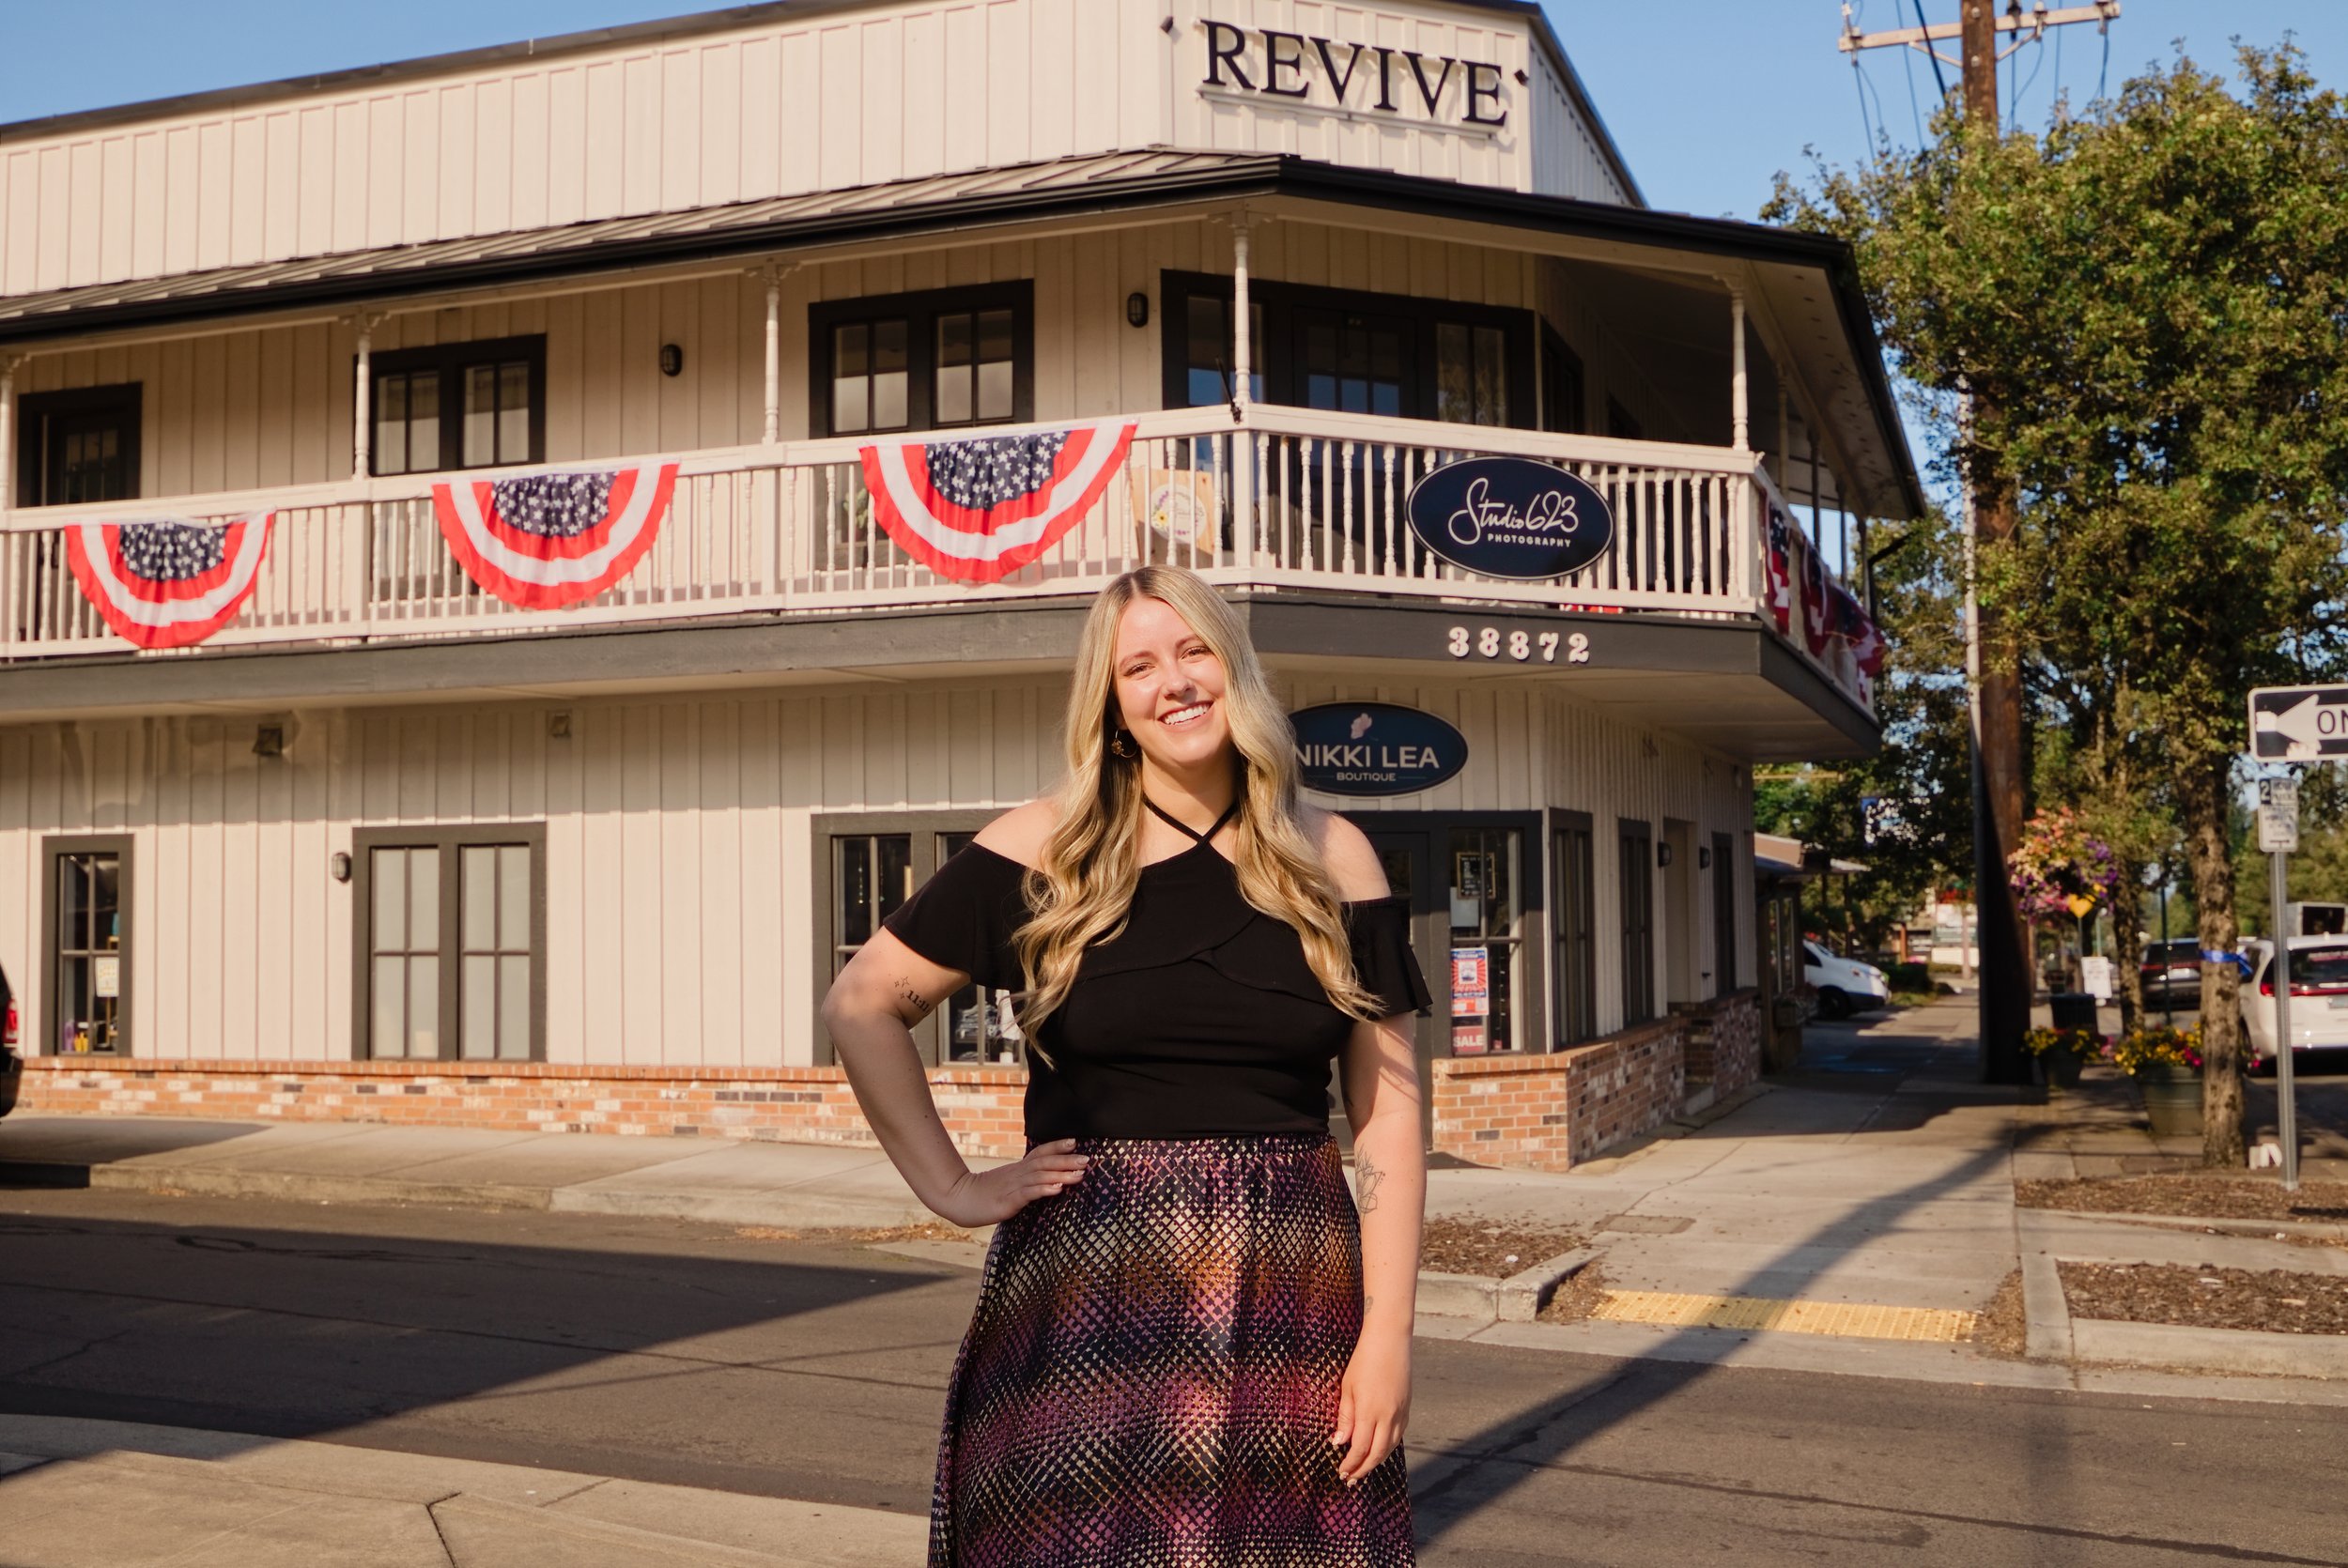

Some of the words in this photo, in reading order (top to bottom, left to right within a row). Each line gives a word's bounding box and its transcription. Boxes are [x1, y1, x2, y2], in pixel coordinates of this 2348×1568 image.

[1200, 19, 1507, 126] REVIVE
[1487, 532, 1571, 547] PHOTOGRAPHY
[1448, 626, 1590, 663] 38872
[1294, 745, 1371, 767] NIKKI
[1383, 746, 1440, 769] LEA
[1336, 773, 1397, 781] BOUTIQUE
[2260, 780, 2270, 801] 2
[906, 990, 930, 1012] 11:11
[1453, 1035, 1484, 1047] SALE
